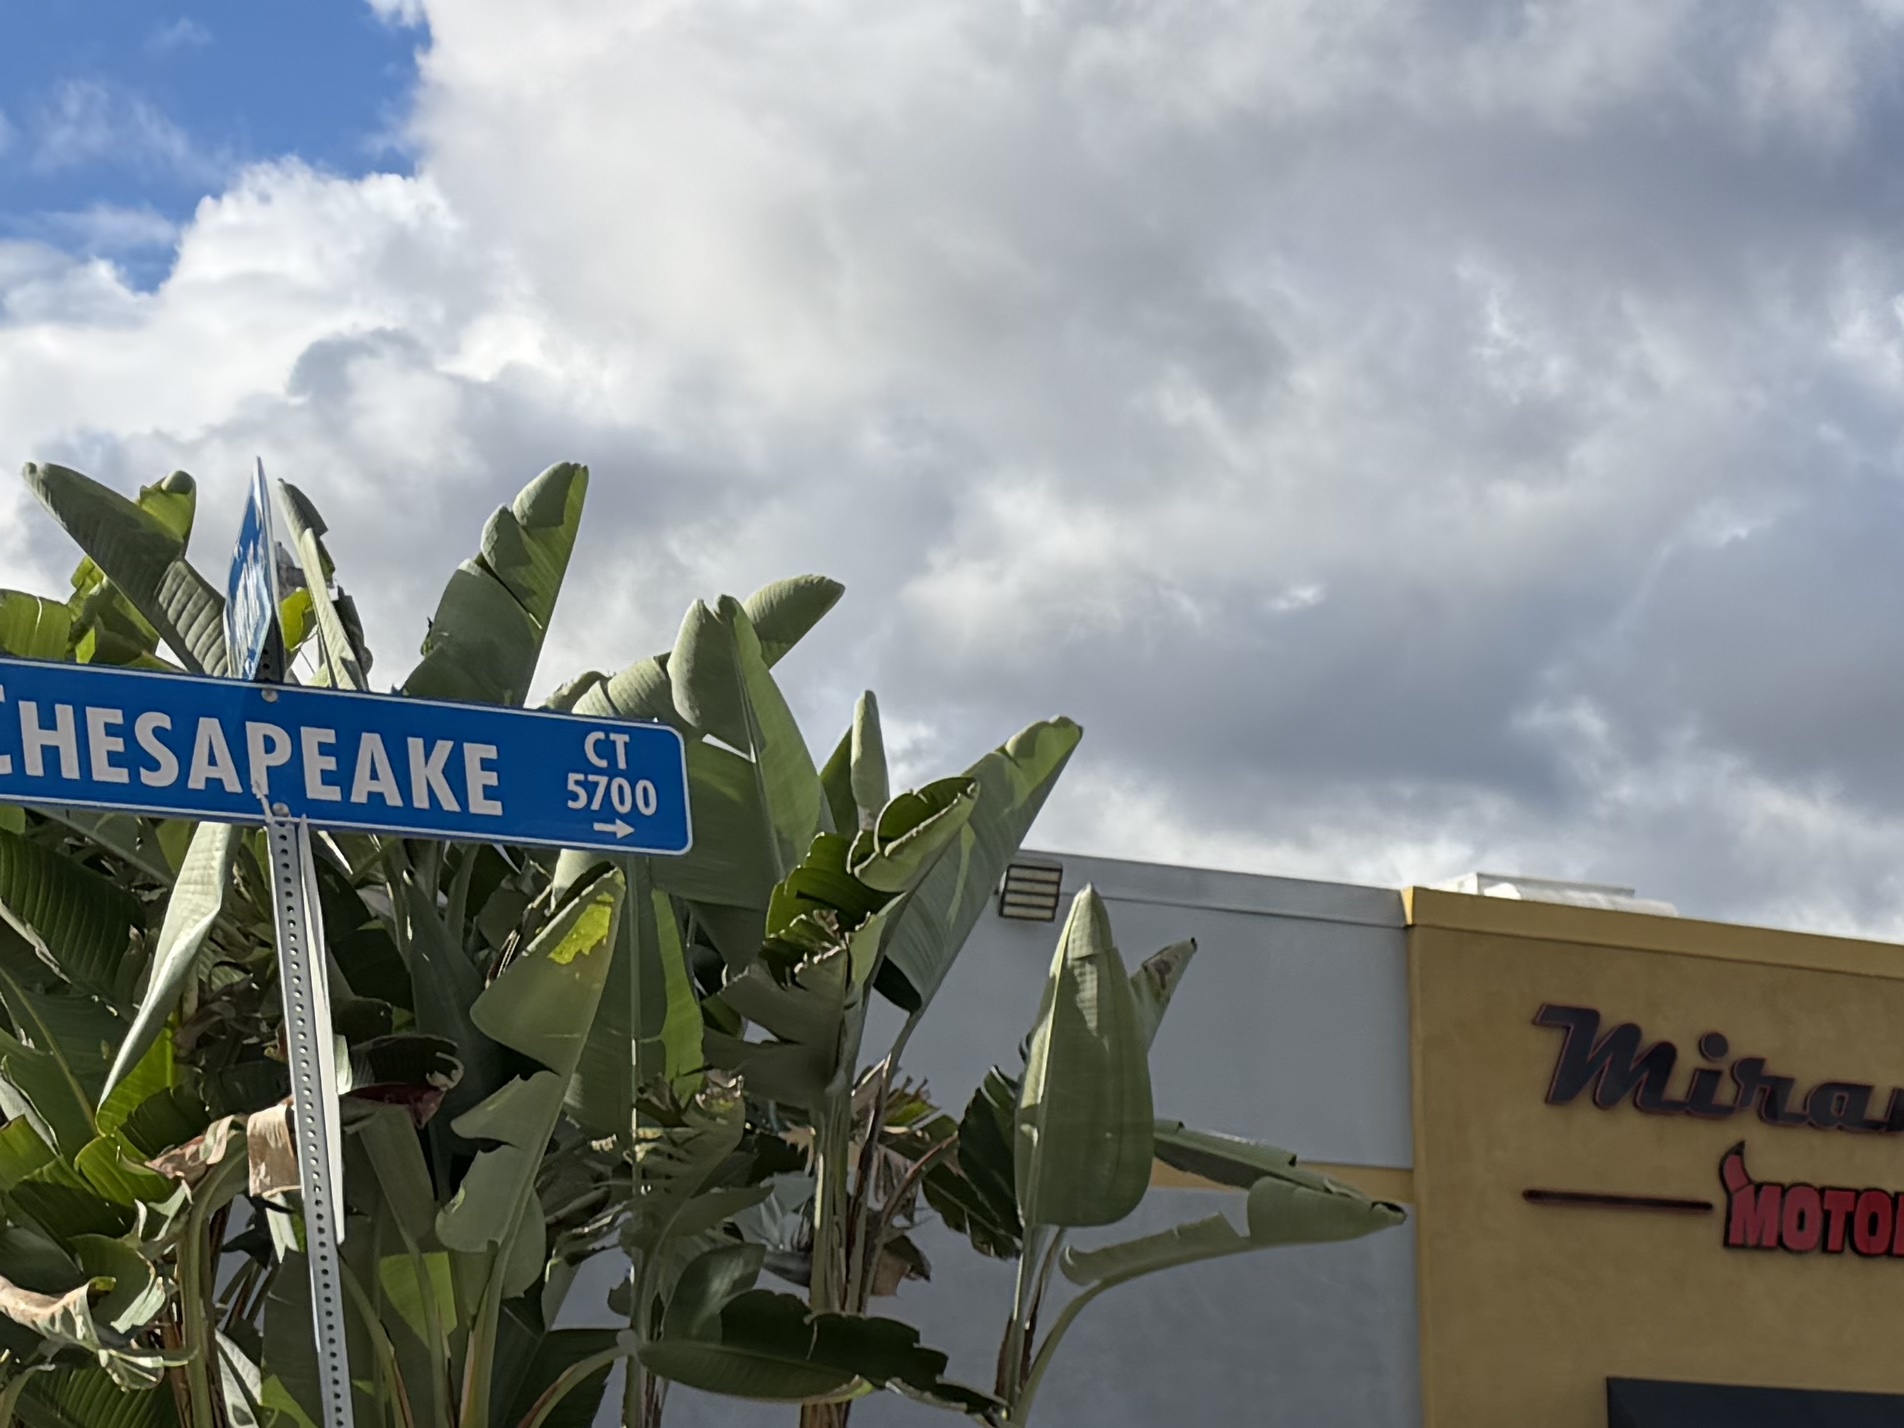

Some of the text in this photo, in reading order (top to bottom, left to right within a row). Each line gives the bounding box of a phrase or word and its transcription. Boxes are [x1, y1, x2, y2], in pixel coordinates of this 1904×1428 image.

[0, 684, 503, 816] HESAPEAKE
[583, 731, 630, 770] CT
[566, 771, 657, 817] 5700
